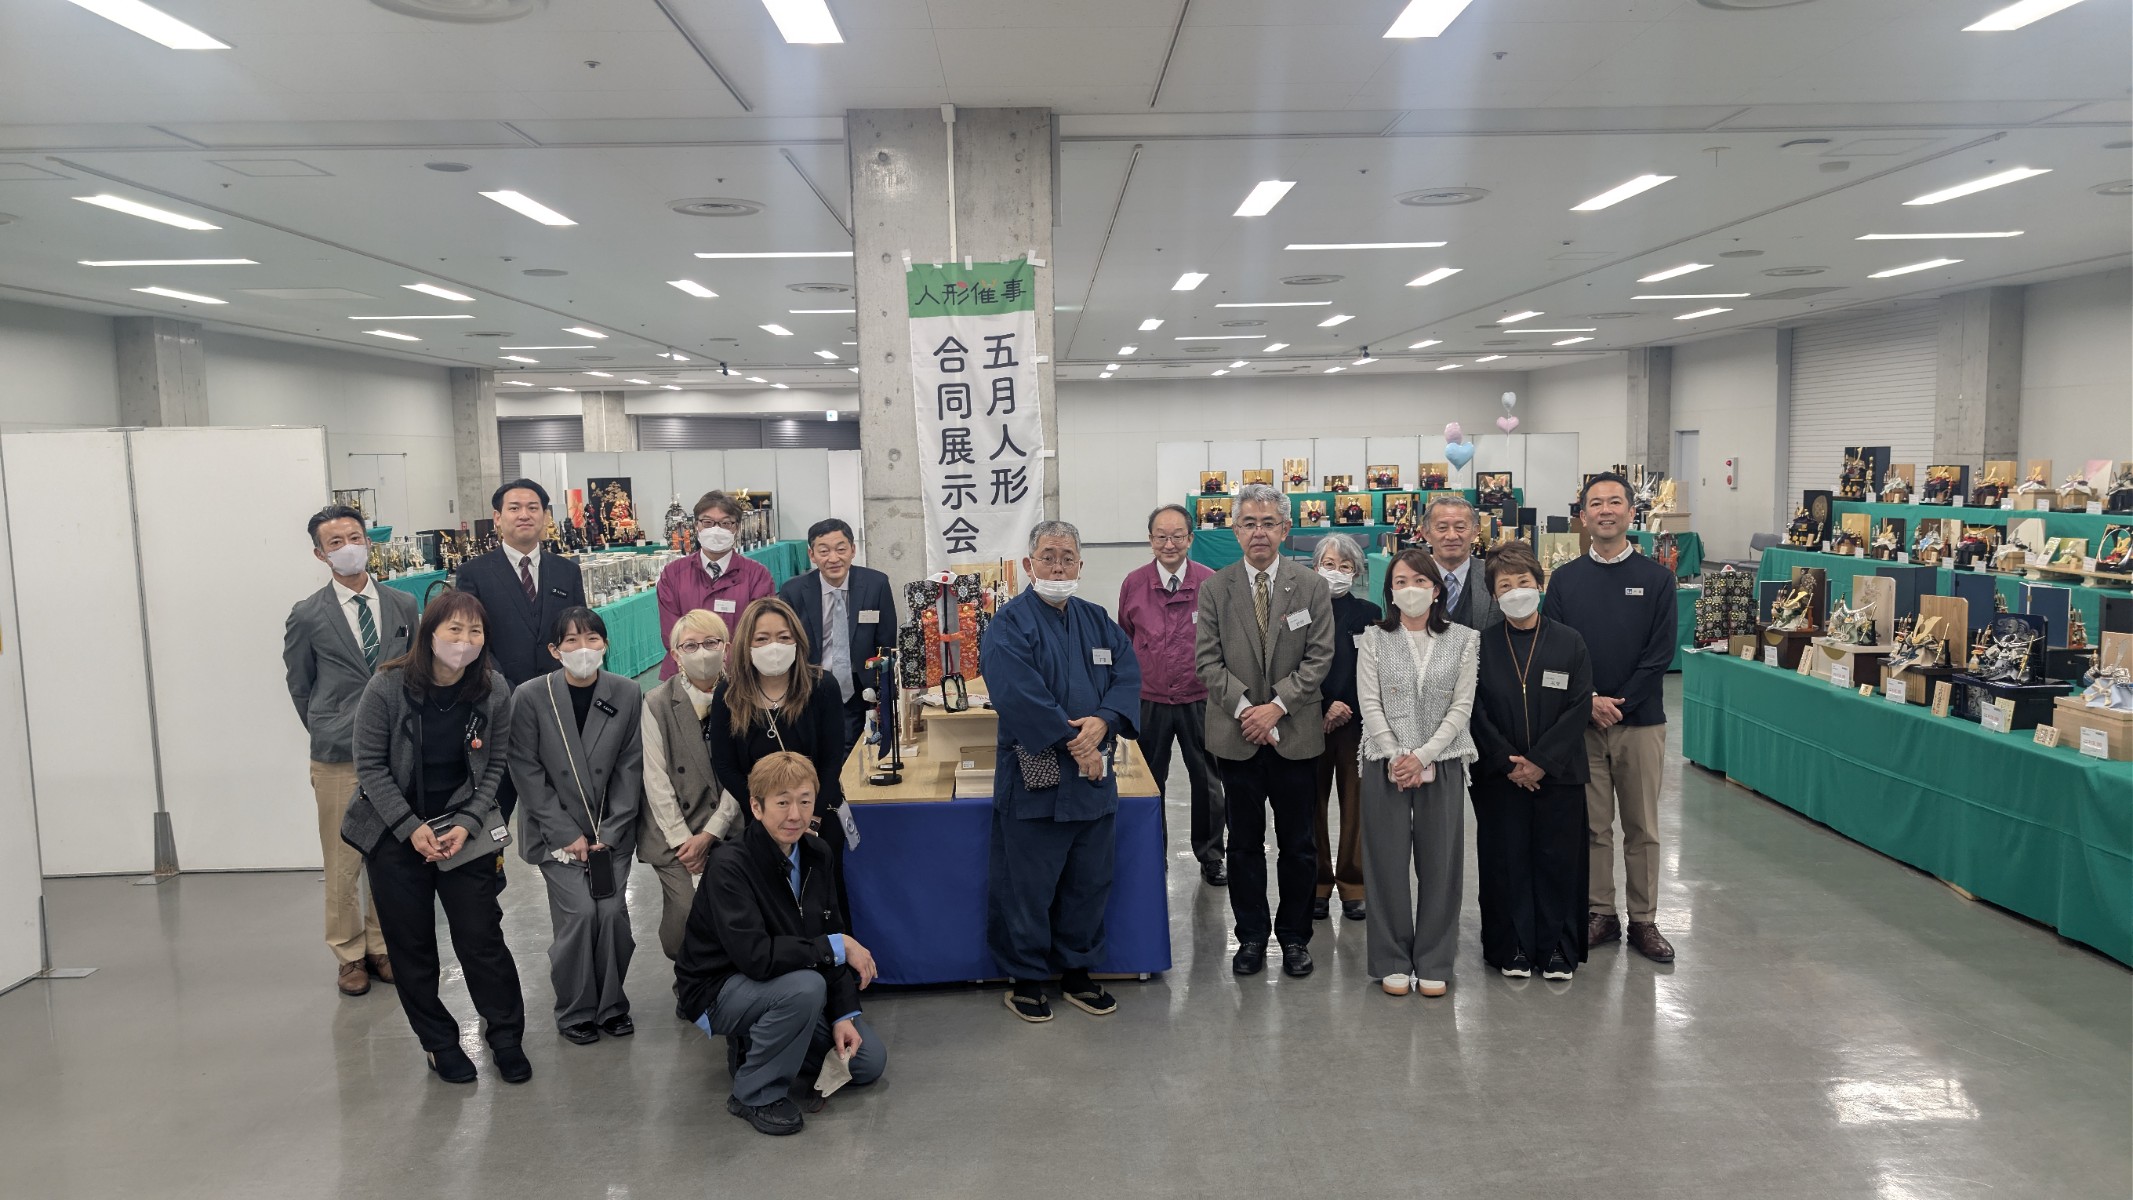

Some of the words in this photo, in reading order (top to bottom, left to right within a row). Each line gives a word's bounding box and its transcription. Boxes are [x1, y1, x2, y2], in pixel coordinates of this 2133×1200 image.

[914, 278, 1027, 306] 人形催事
[932, 335, 980, 555] 合同展示会
[982, 332, 1029, 506] 五月人形
